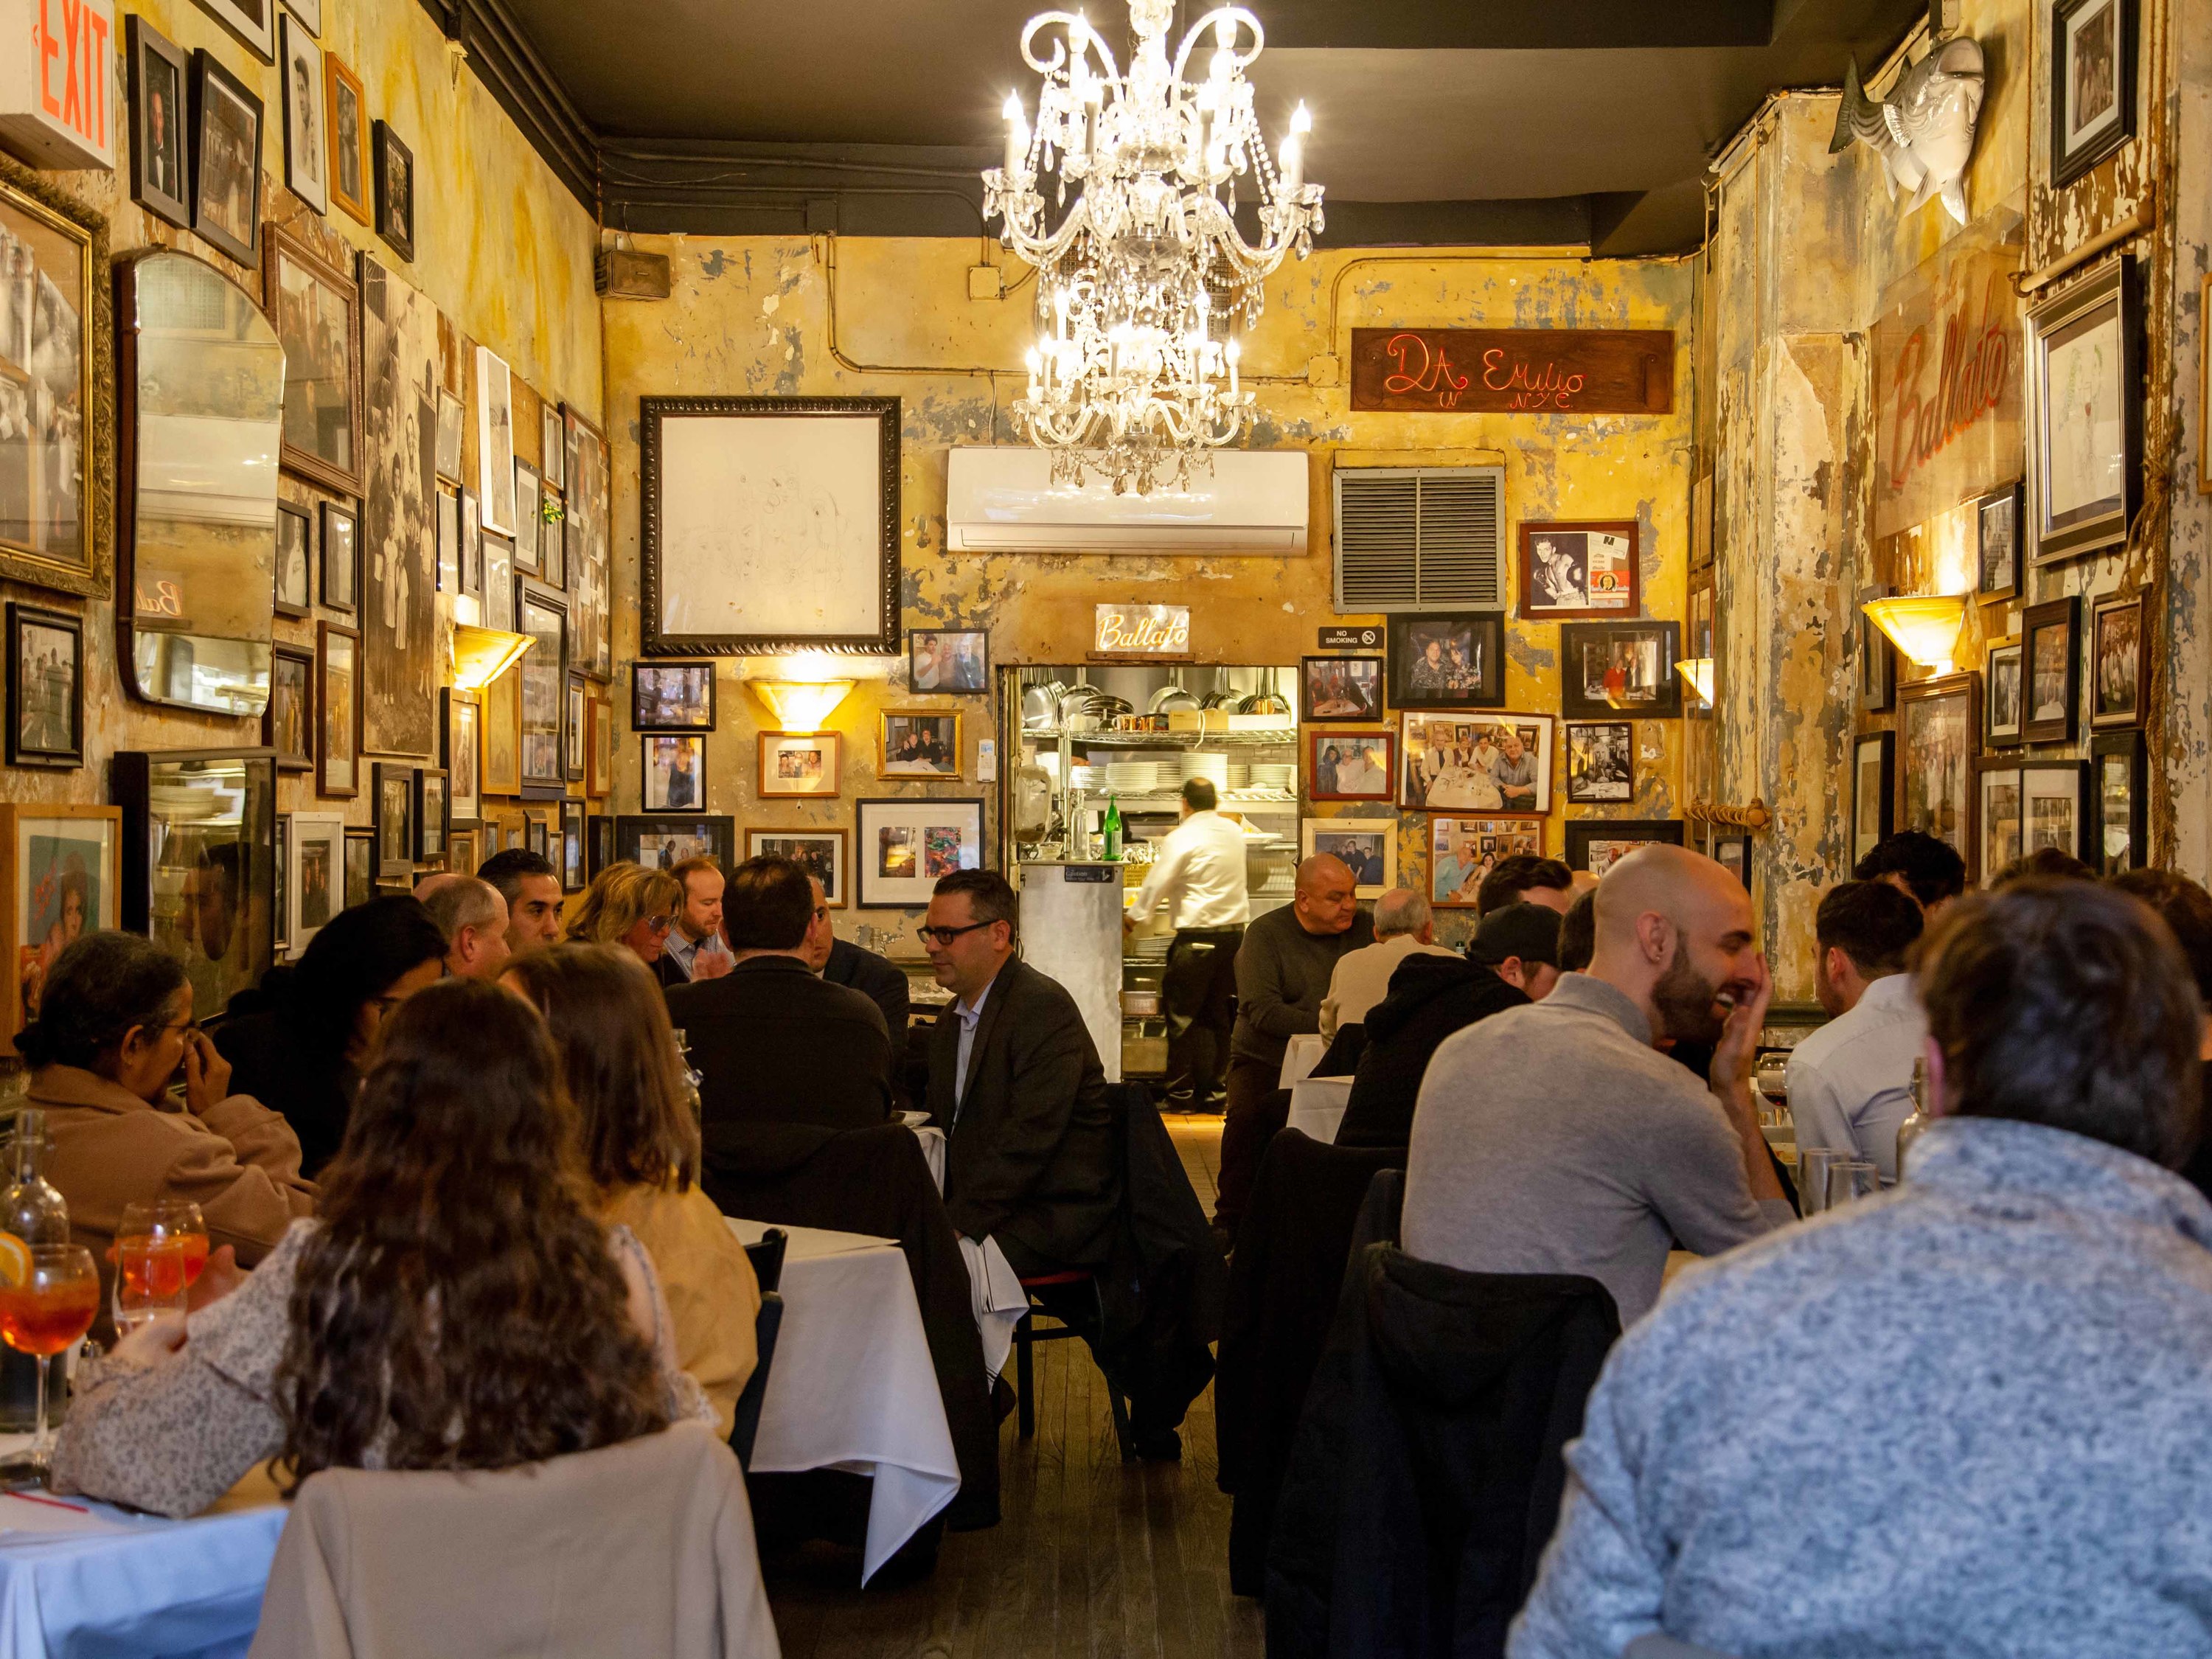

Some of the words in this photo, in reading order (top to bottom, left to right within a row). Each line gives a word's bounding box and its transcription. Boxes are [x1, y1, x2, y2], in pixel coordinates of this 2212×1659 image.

[40, 0, 108, 150] EXIT
[1891, 269, 2008, 490] Ballato
[1099, 614, 1188, 650] Ballato
